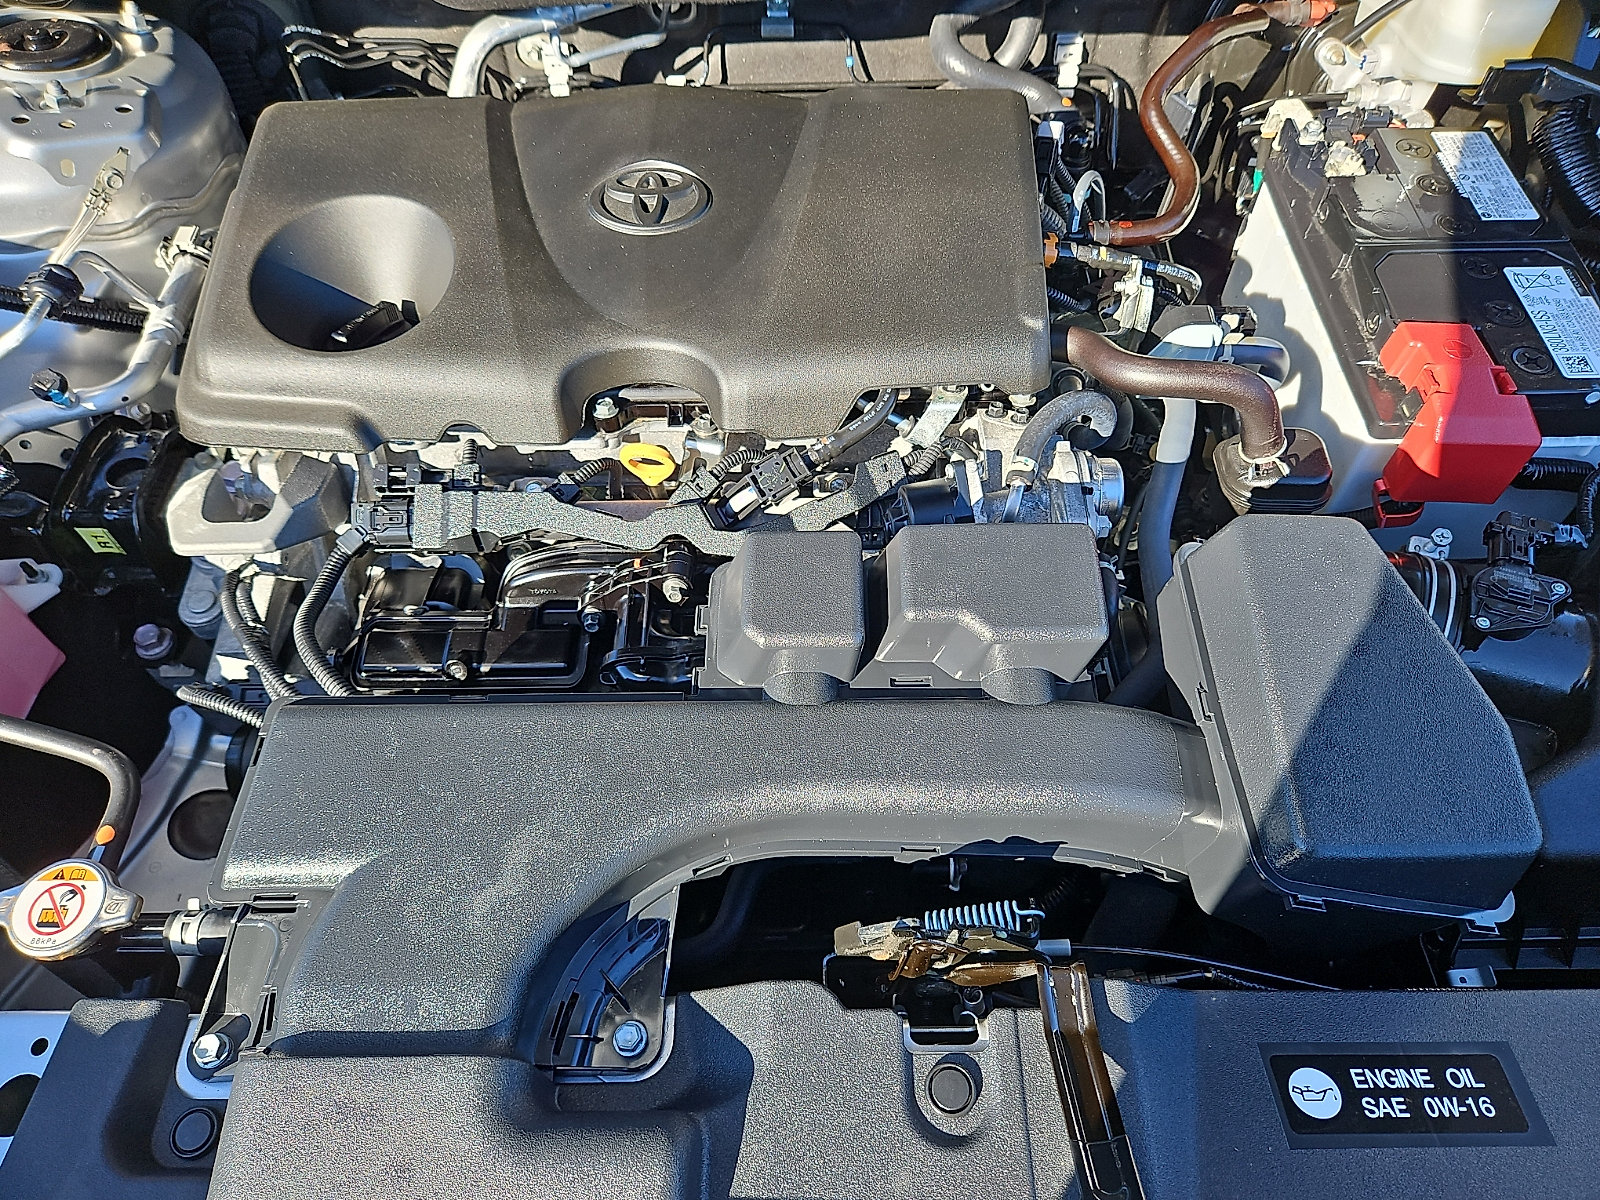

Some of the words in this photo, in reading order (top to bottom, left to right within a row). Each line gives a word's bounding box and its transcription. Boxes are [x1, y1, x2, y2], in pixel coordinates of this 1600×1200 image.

[1349, 1068, 1435, 1089] ENGINE
[1445, 1067, 1485, 1088] OIL
[1362, 1096, 1411, 1118] SAE
[1424, 1096, 1496, 1118] 0W-16
